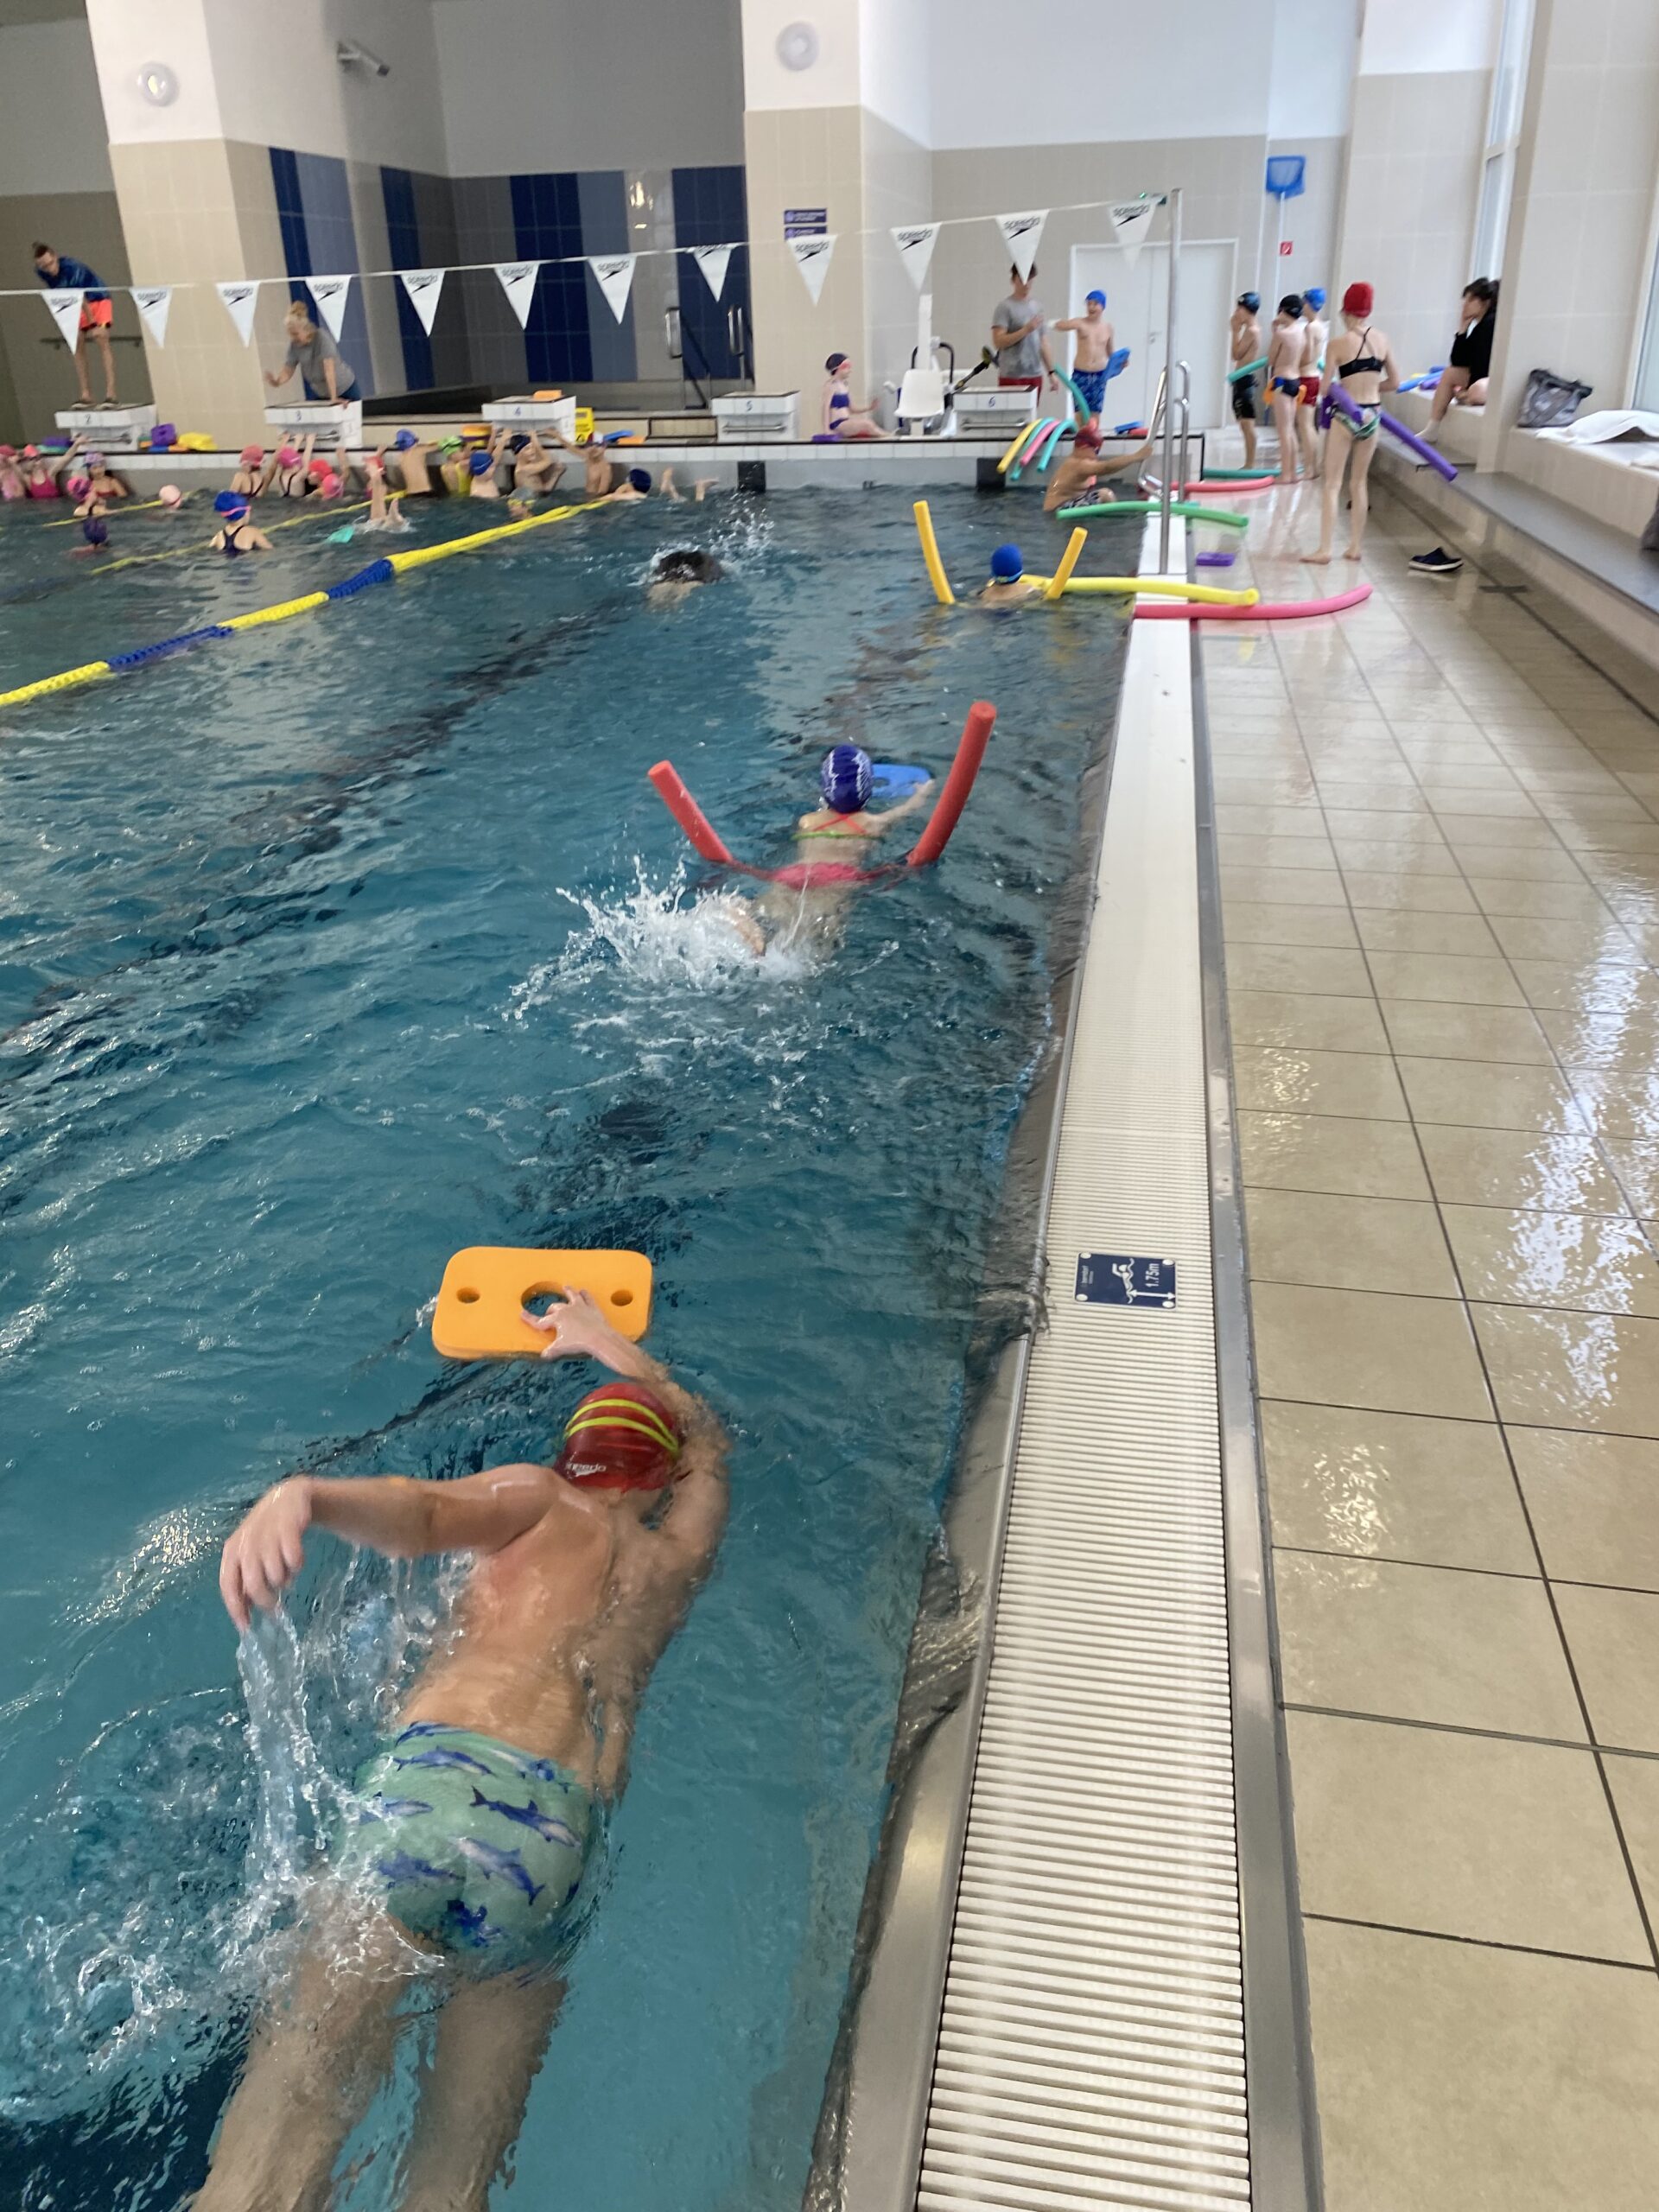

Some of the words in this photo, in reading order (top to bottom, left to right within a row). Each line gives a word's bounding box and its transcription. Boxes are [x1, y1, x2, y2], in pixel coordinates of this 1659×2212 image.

[1003, 216, 1040, 231] speedo
[898, 228, 933, 242] speedo
[795, 240, 830, 254] speedo
[988, 395, 995, 408] 6
[1145, 1263, 1160, 1287] 1.75m
